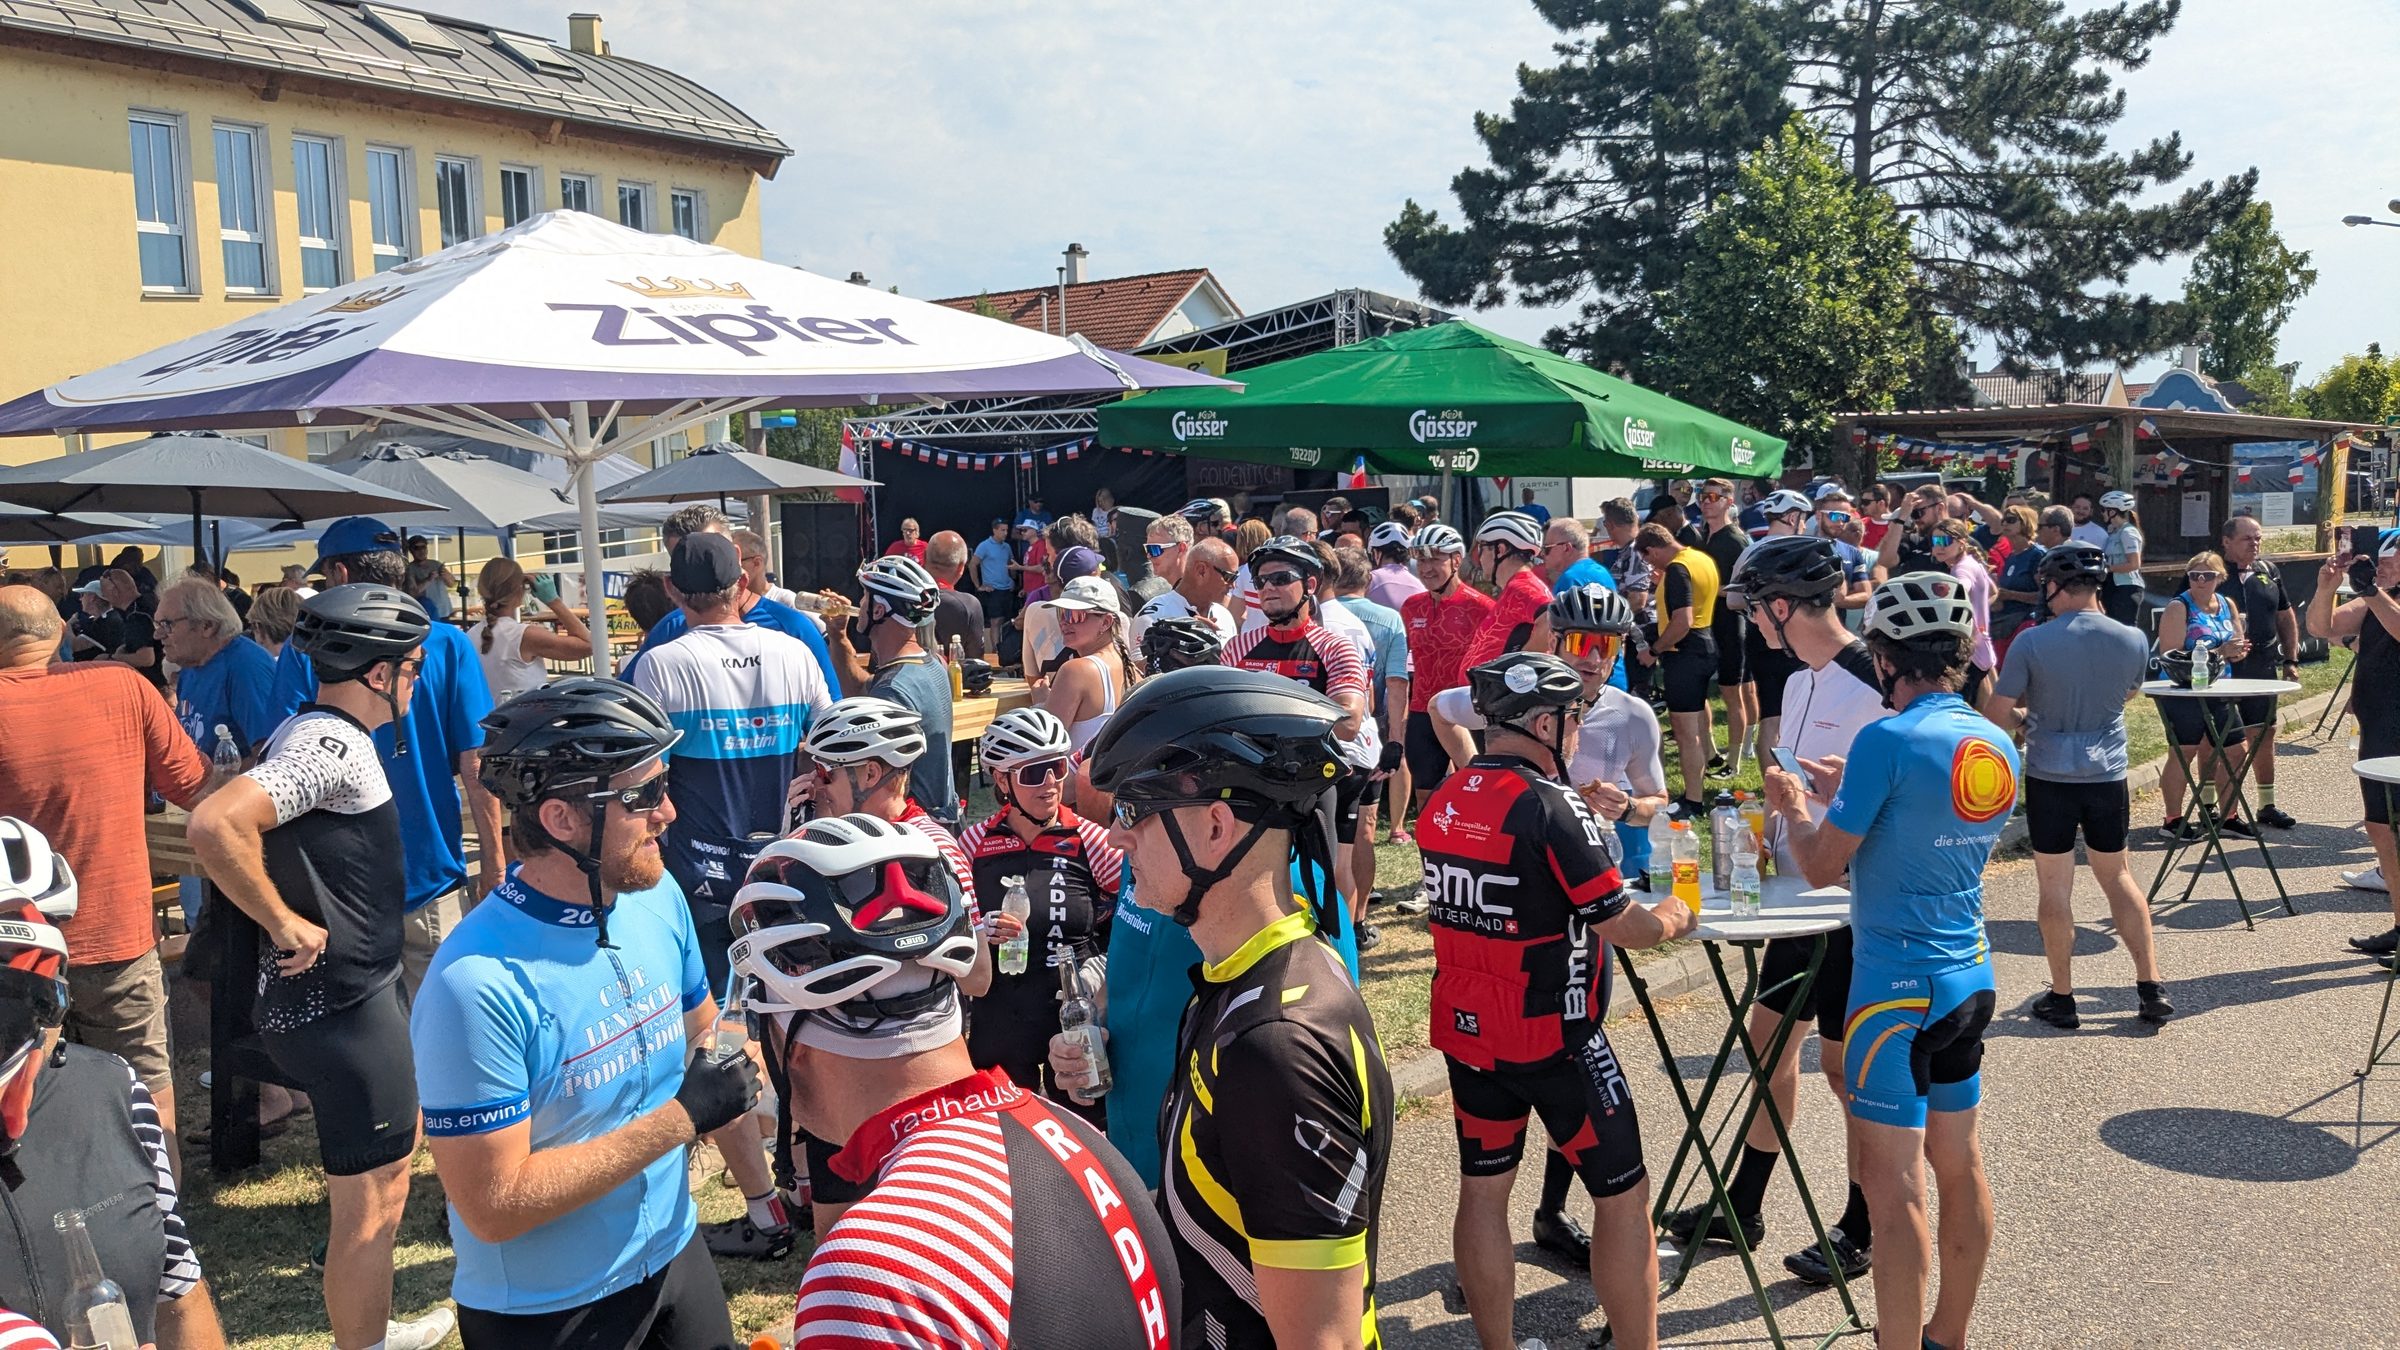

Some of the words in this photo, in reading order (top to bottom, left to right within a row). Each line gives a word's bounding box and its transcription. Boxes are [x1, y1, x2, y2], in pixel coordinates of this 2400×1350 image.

[545, 303, 918, 356] Zipfer
[1172, 411, 1228, 441] Gösser
[1409, 410, 1477, 443] Gösser
[1624, 417, 1655, 449] Gösser
[1731, 437, 1755, 466] Gösser
[721, 655, 761, 668] KASK
[701, 718, 728, 731] DE
[736, 713, 794, 731] ROSA
[852, 722, 881, 734] GIRO
[723, 734, 777, 750] Santini
[1461, 821, 1492, 832] coquillade
[1005, 837, 1020, 849] 55
[1934, 834, 1954, 847] die
[501, 882, 526, 905] See
[1424, 857, 1520, 916] BMC
[899, 935, 925, 947] ABUS
[600, 966, 650, 1008] CAFE
[1856, 1095, 1900, 1111] burgenland
